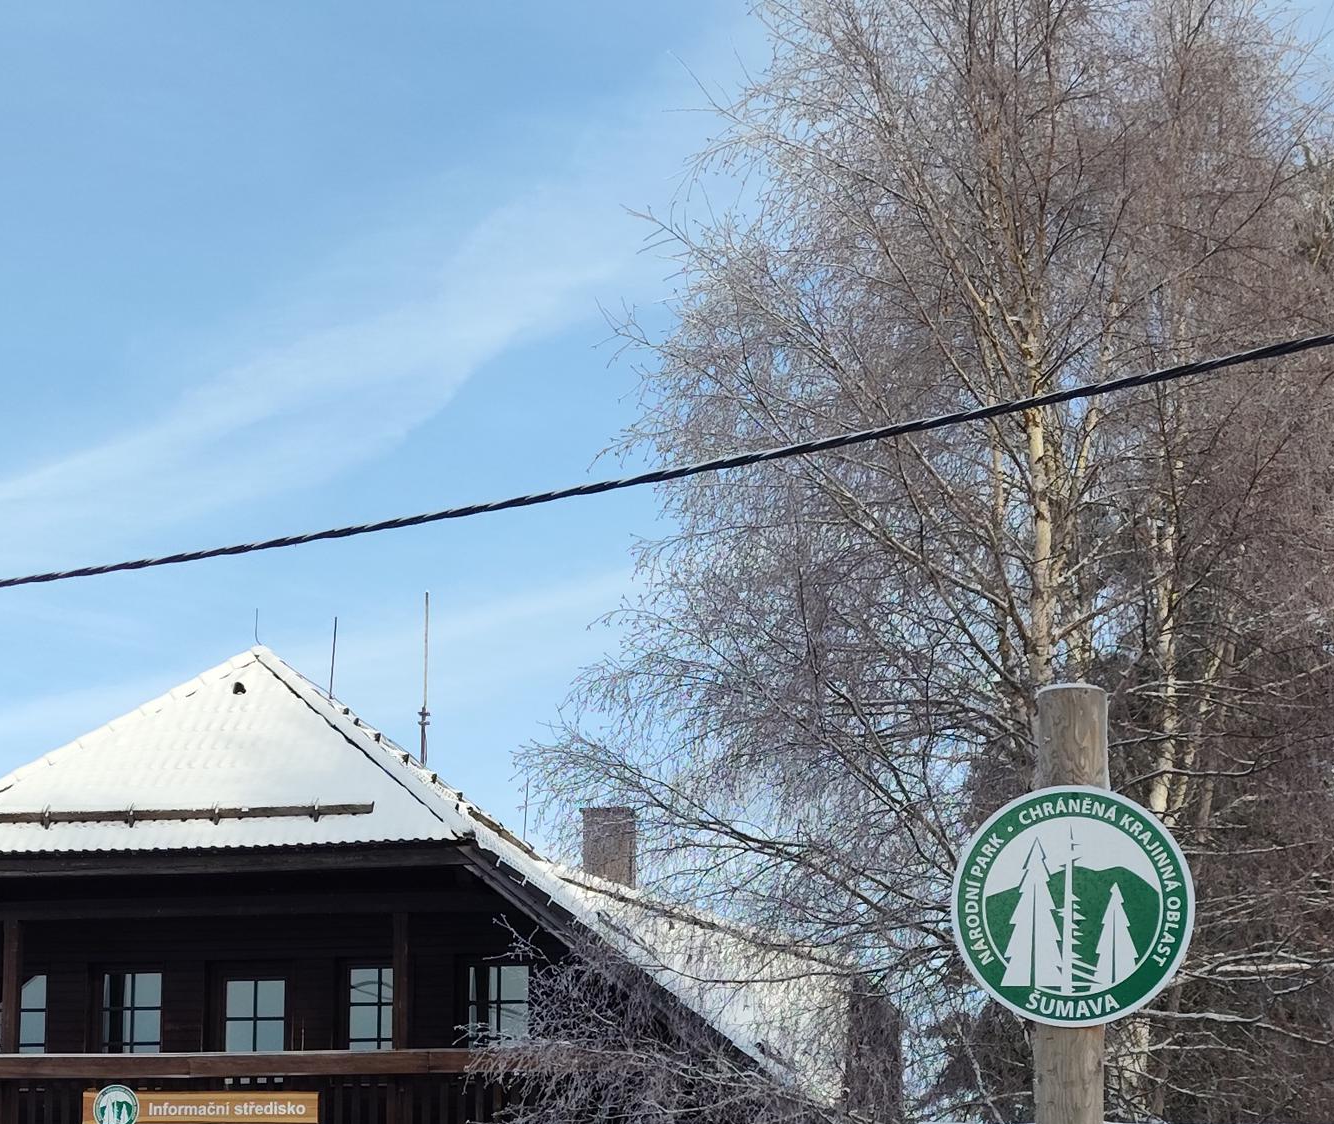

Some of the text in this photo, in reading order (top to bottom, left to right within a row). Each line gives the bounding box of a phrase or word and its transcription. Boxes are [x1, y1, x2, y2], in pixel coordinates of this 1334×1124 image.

[964, 797, 1181, 968] NÁRODNÍ PARK CHRÁNĚNÁ KRAJINNÁ OBLAST
[1025, 990, 1120, 1018] ŠUMAVA
[148, 1101, 306, 1116] Informační středisko
